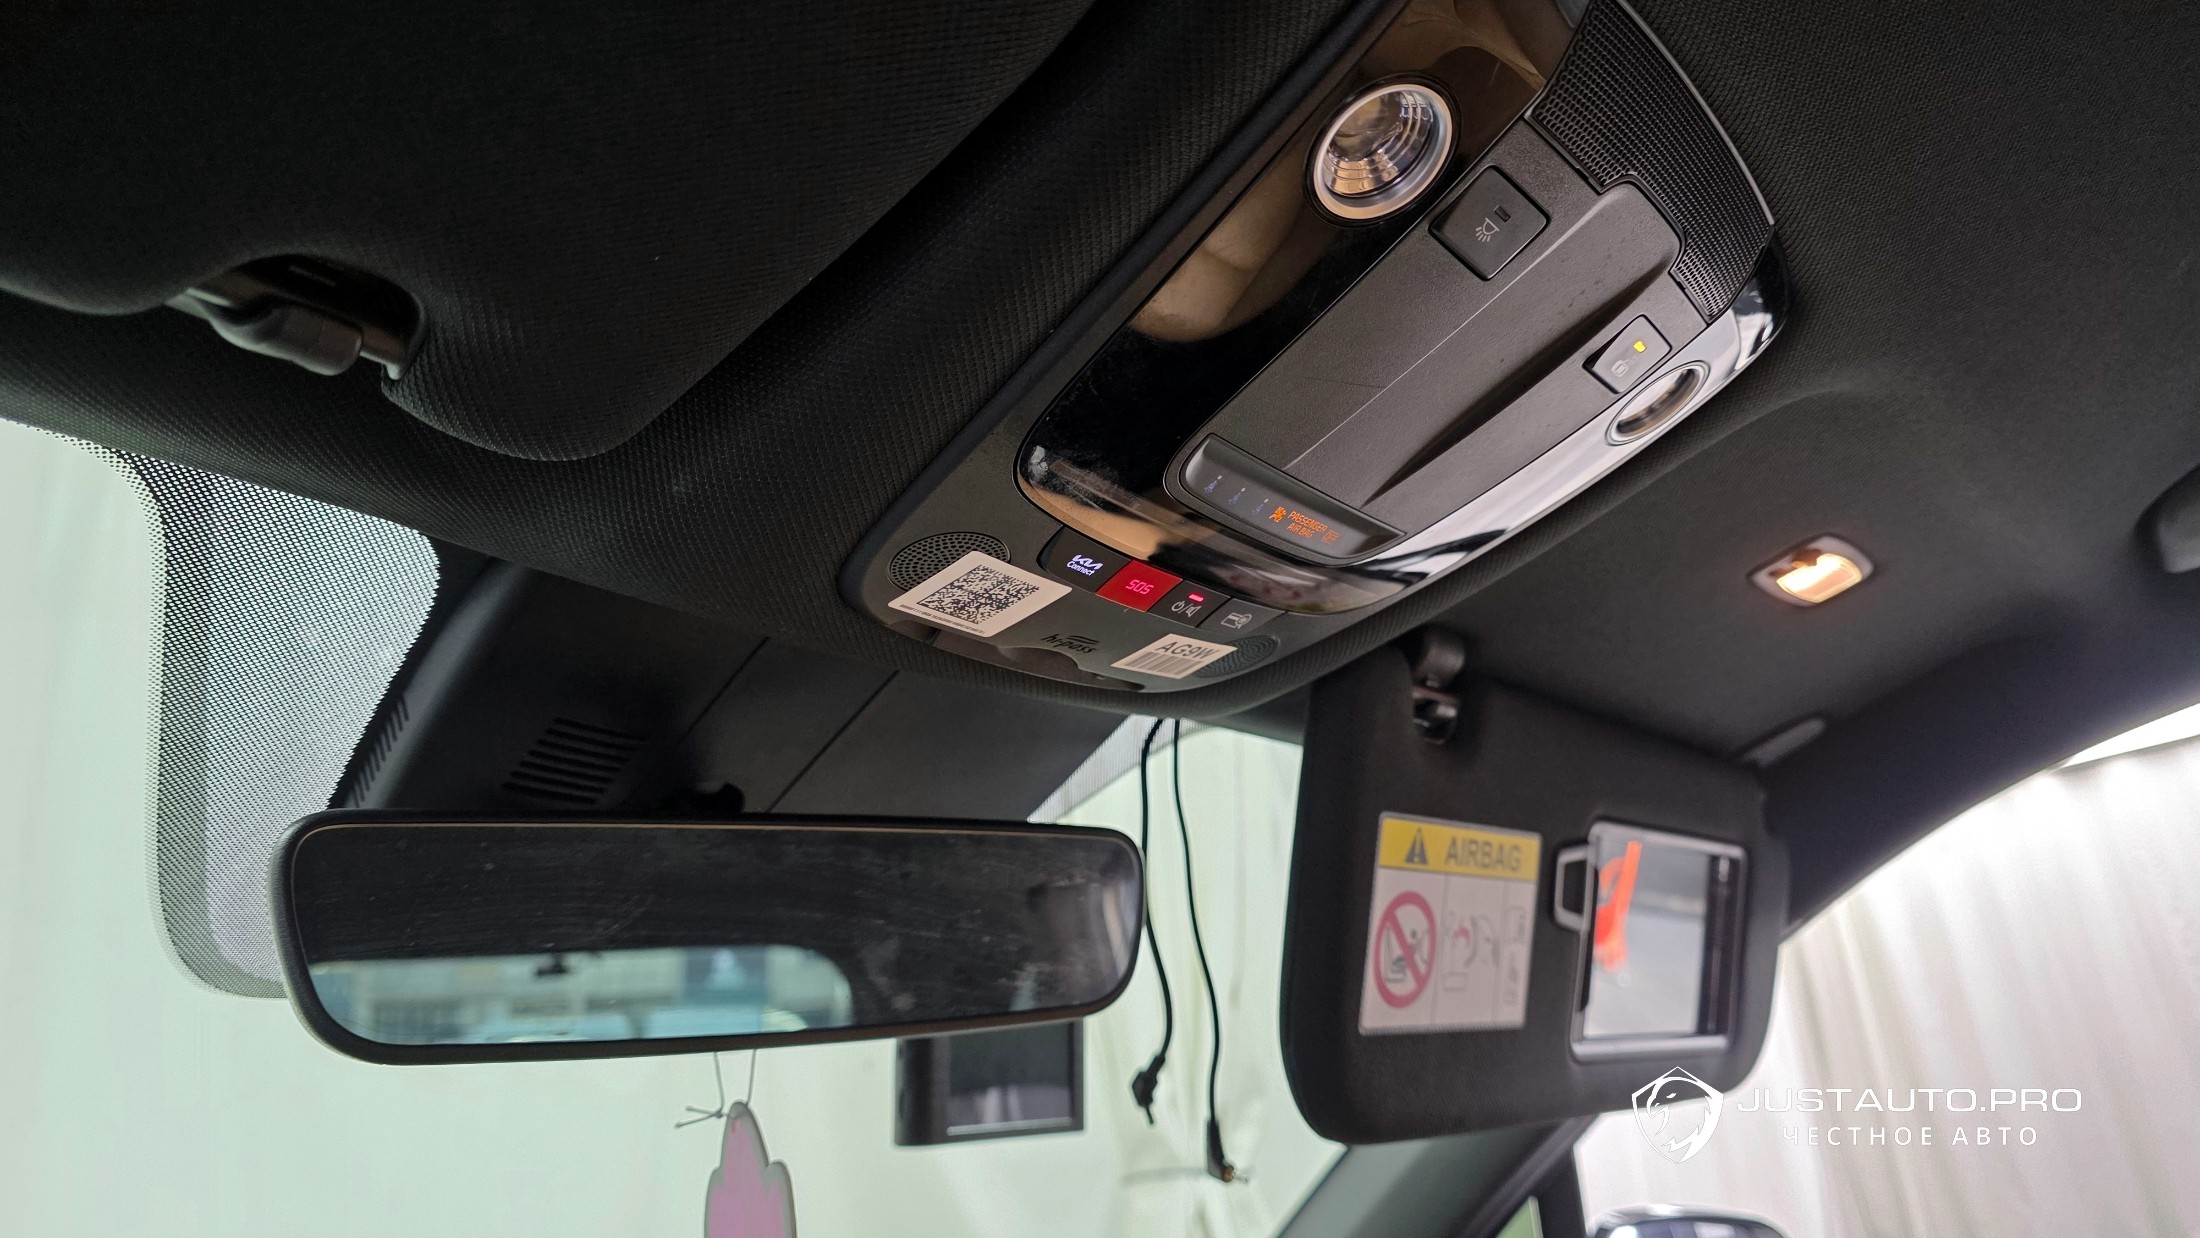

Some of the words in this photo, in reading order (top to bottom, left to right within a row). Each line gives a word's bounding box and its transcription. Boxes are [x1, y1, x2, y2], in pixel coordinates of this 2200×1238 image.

[1287, 511, 1327, 533] PASSENGER
[1066, 560, 1095, 576] Connect
[1125, 579, 1155, 595] SOS
[1154, 641, 1219, 660] AG9W
[1444, 835, 1523, 873] AIRBAG
